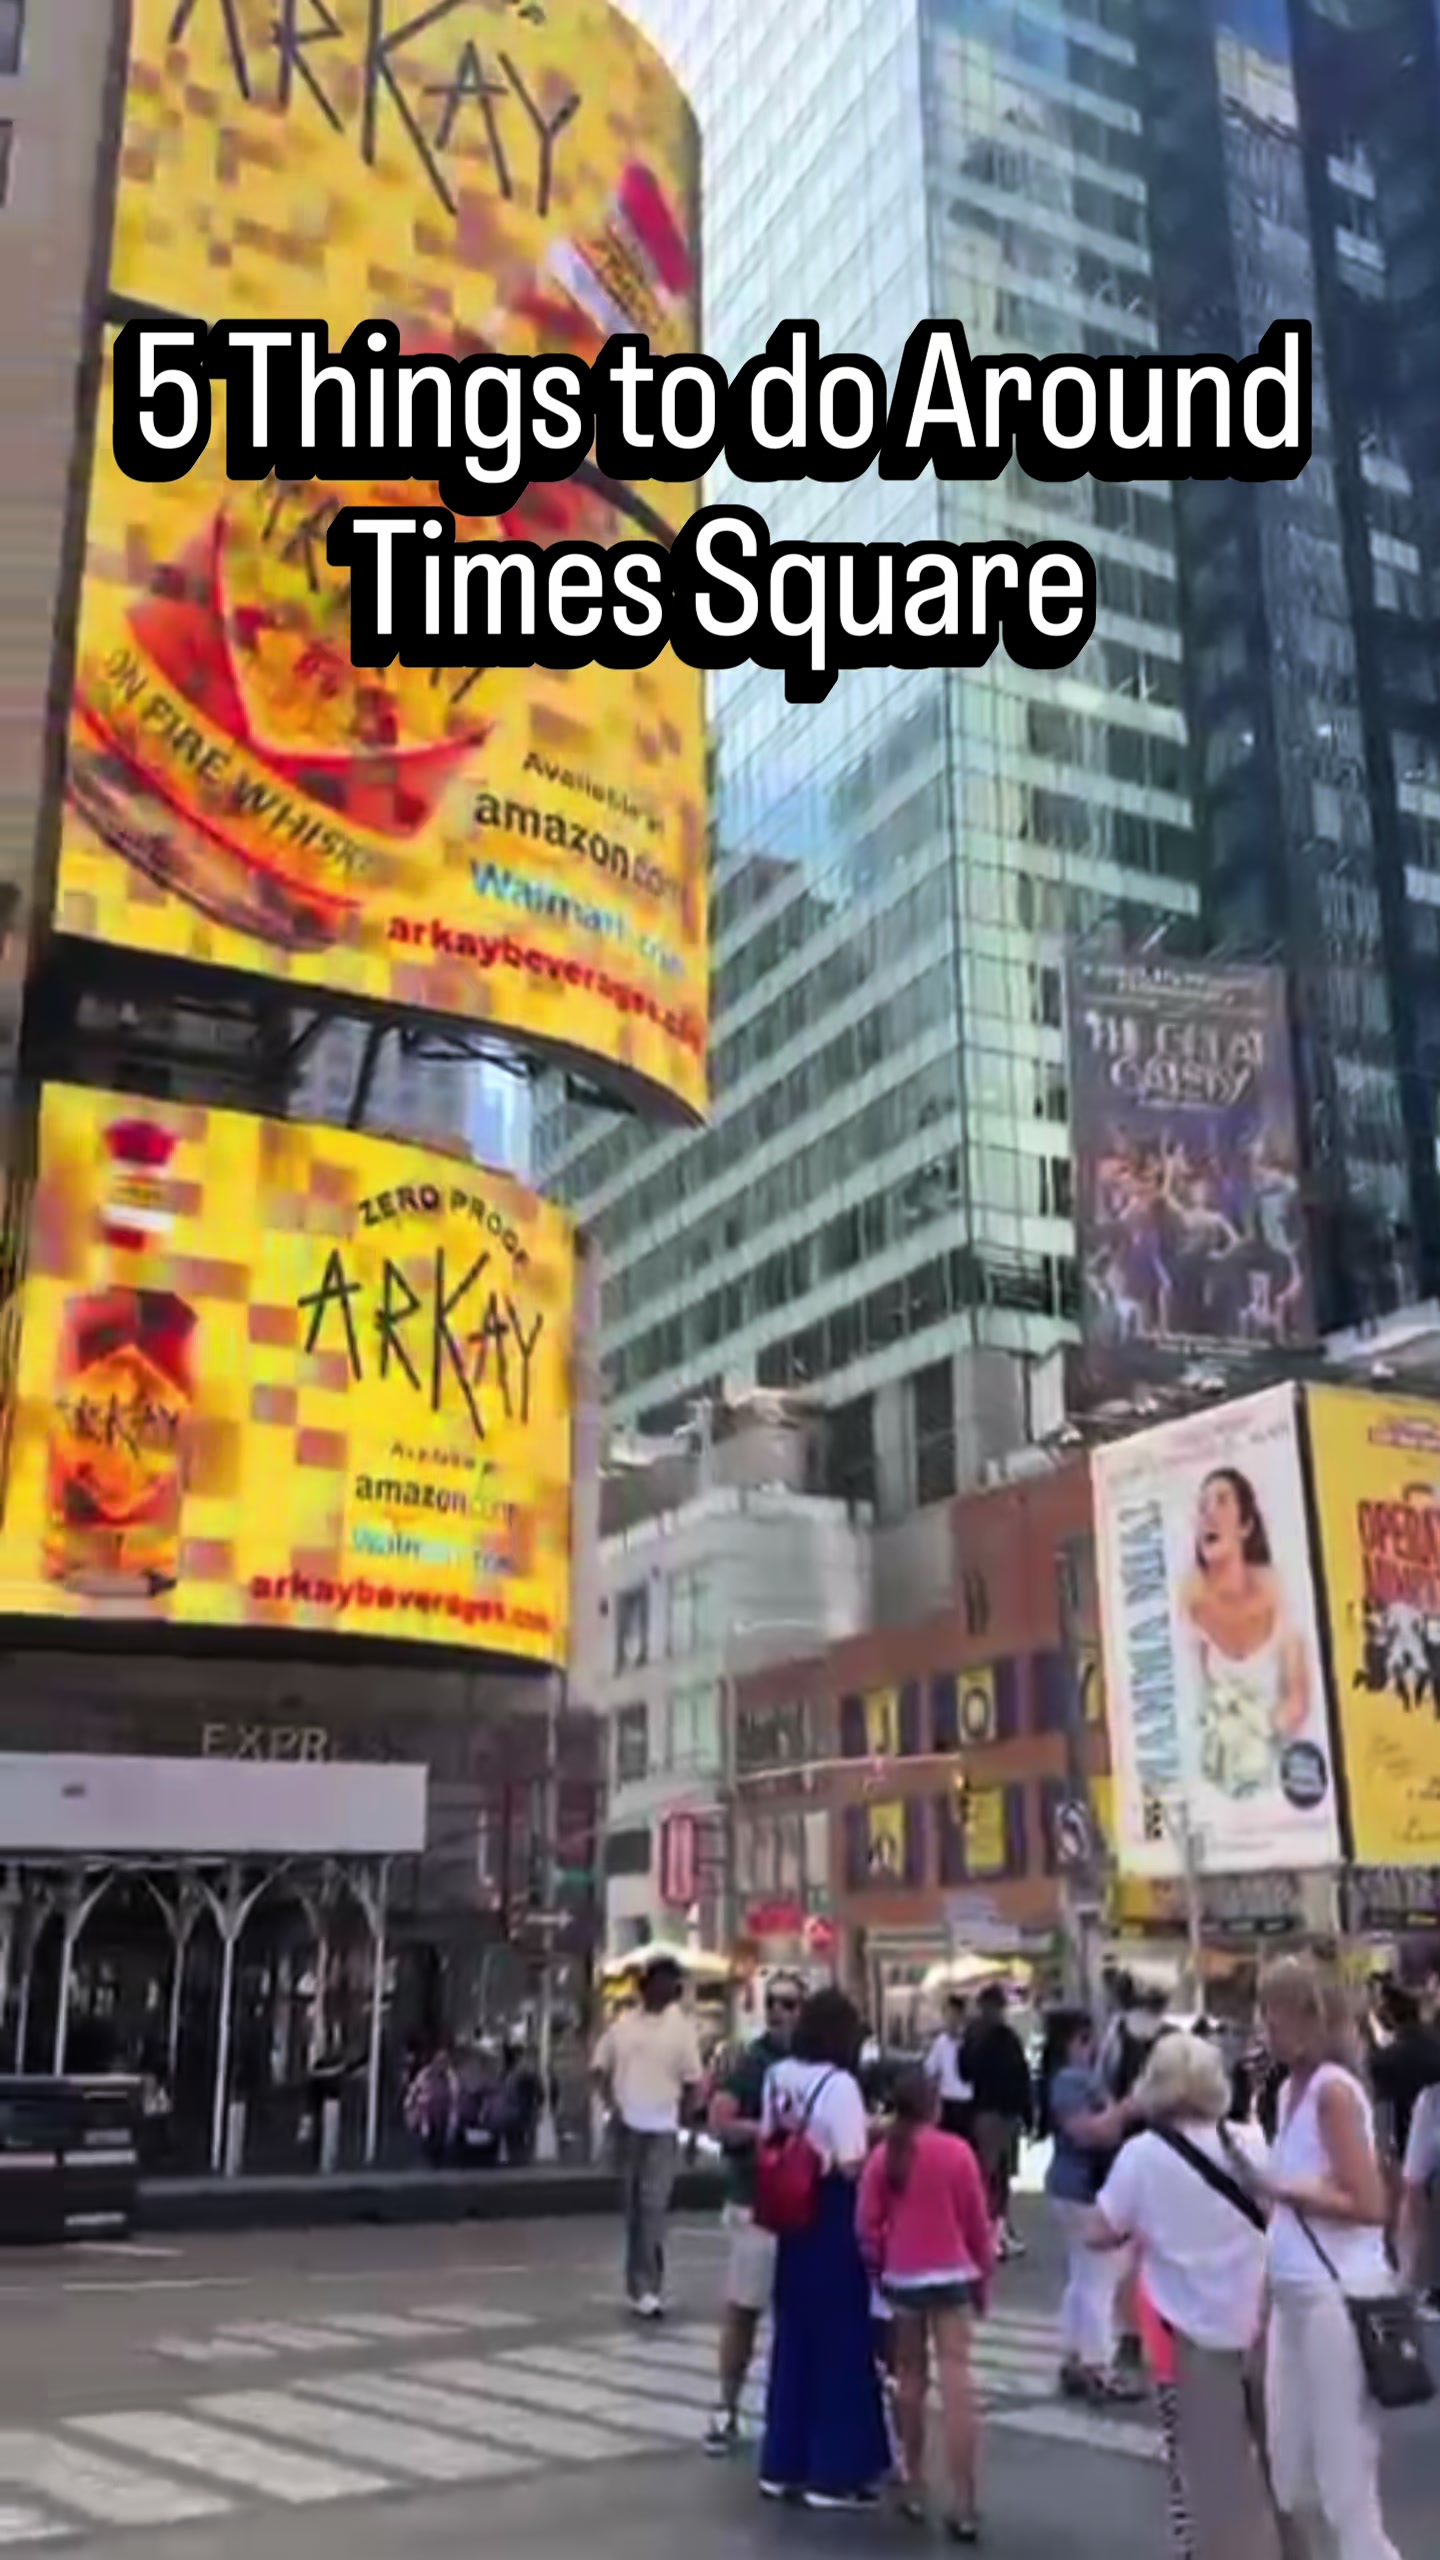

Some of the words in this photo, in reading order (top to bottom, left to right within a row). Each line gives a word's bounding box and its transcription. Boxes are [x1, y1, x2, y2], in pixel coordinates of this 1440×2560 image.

[140, 693, 232, 780] FIRE
[357, 1183, 441, 1227] ZERO
[297, 1245, 546, 1441] ARKAY
